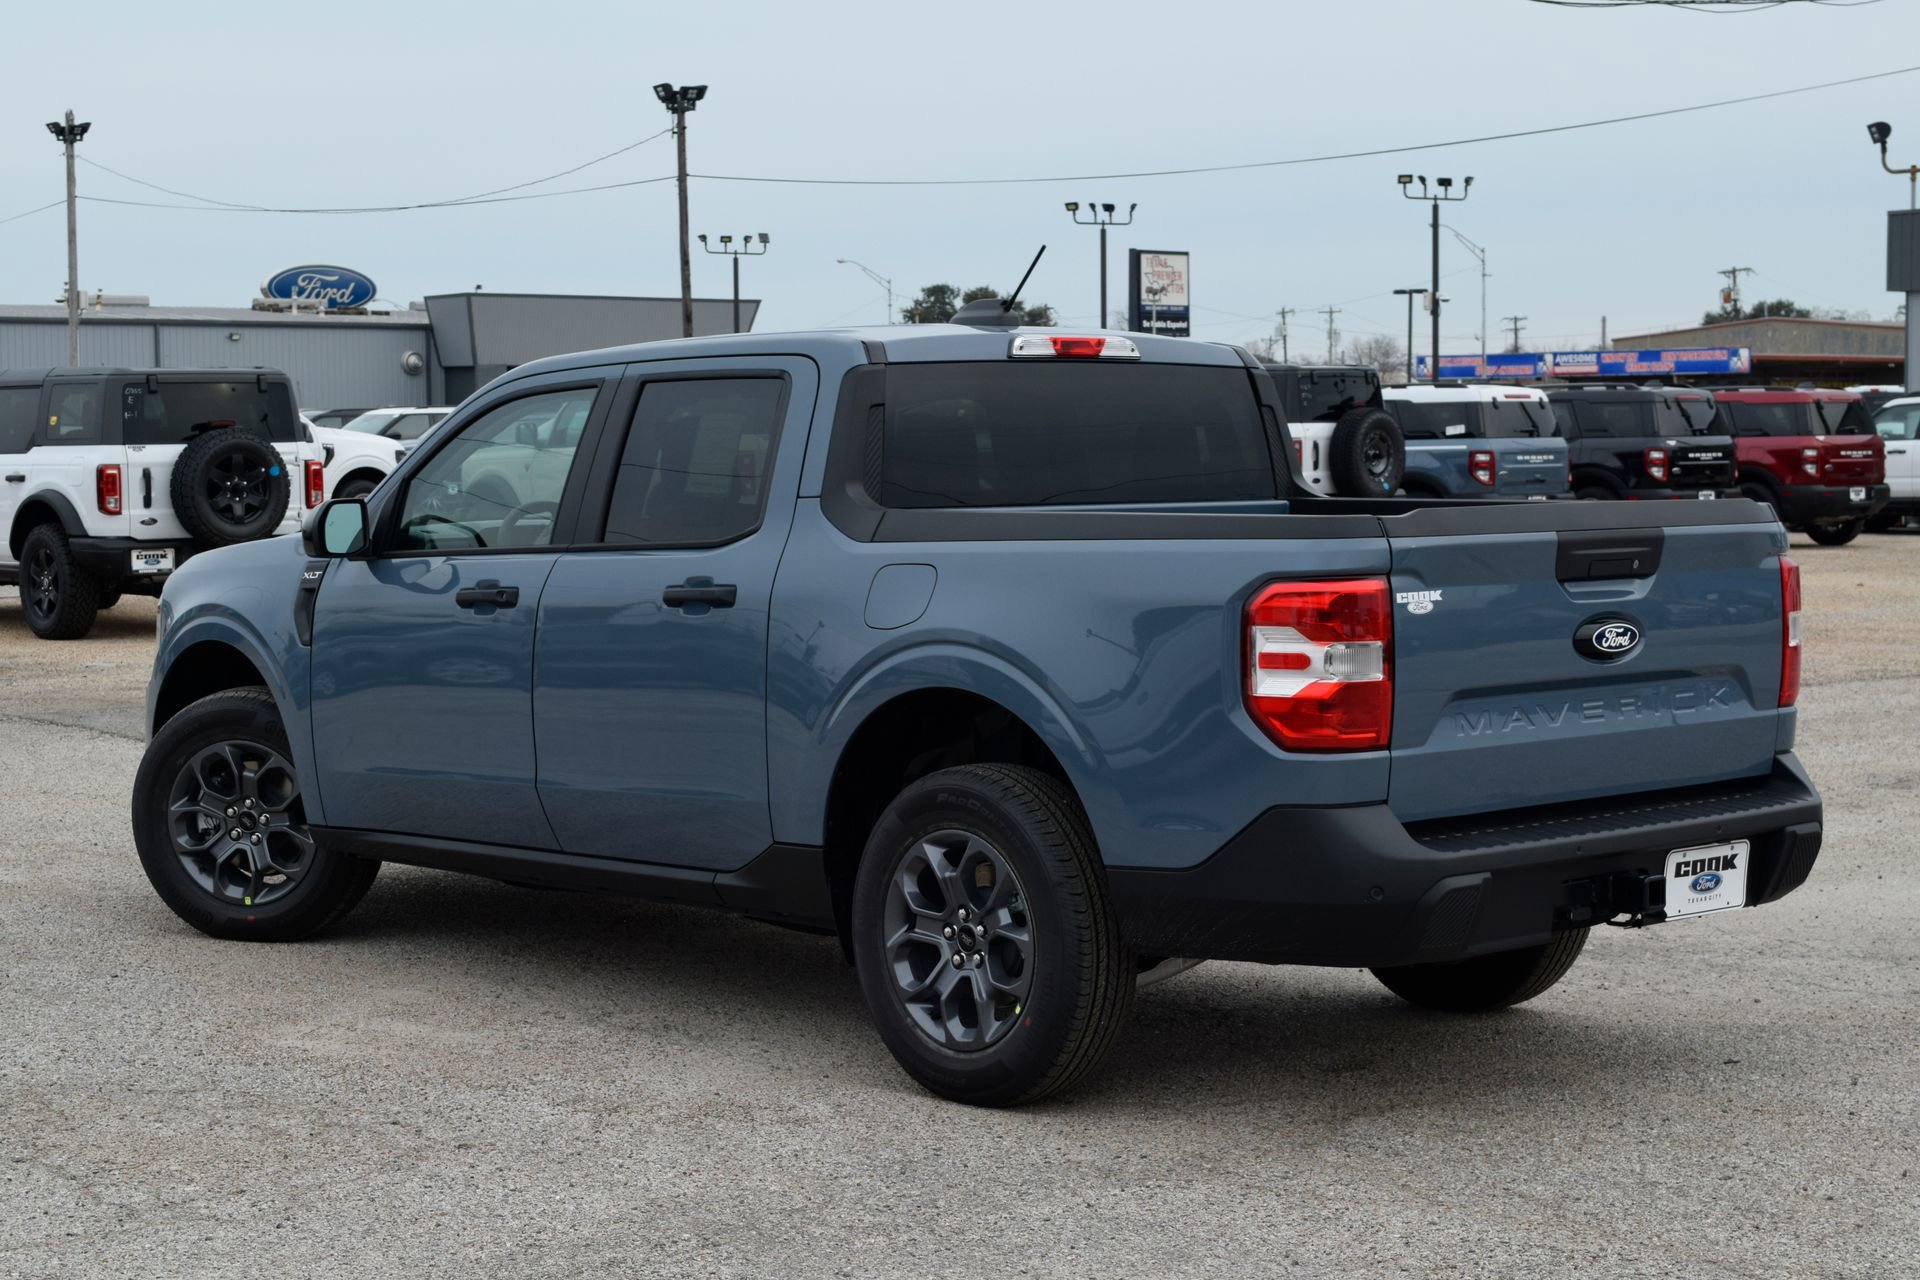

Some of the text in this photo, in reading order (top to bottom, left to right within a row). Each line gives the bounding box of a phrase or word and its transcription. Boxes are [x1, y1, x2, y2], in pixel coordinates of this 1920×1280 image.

[297, 273, 356, 303] Ford
[1555, 354, 1597, 364] AWESOME
[302, 571, 323, 579] XLT
[1396, 590, 1443, 603] COOK
[1602, 628, 1631, 648] Ford
[1455, 687, 1729, 737] MAVERICK
[1674, 853, 1739, 878] COOK
[1696, 876, 1717, 890] Ford
